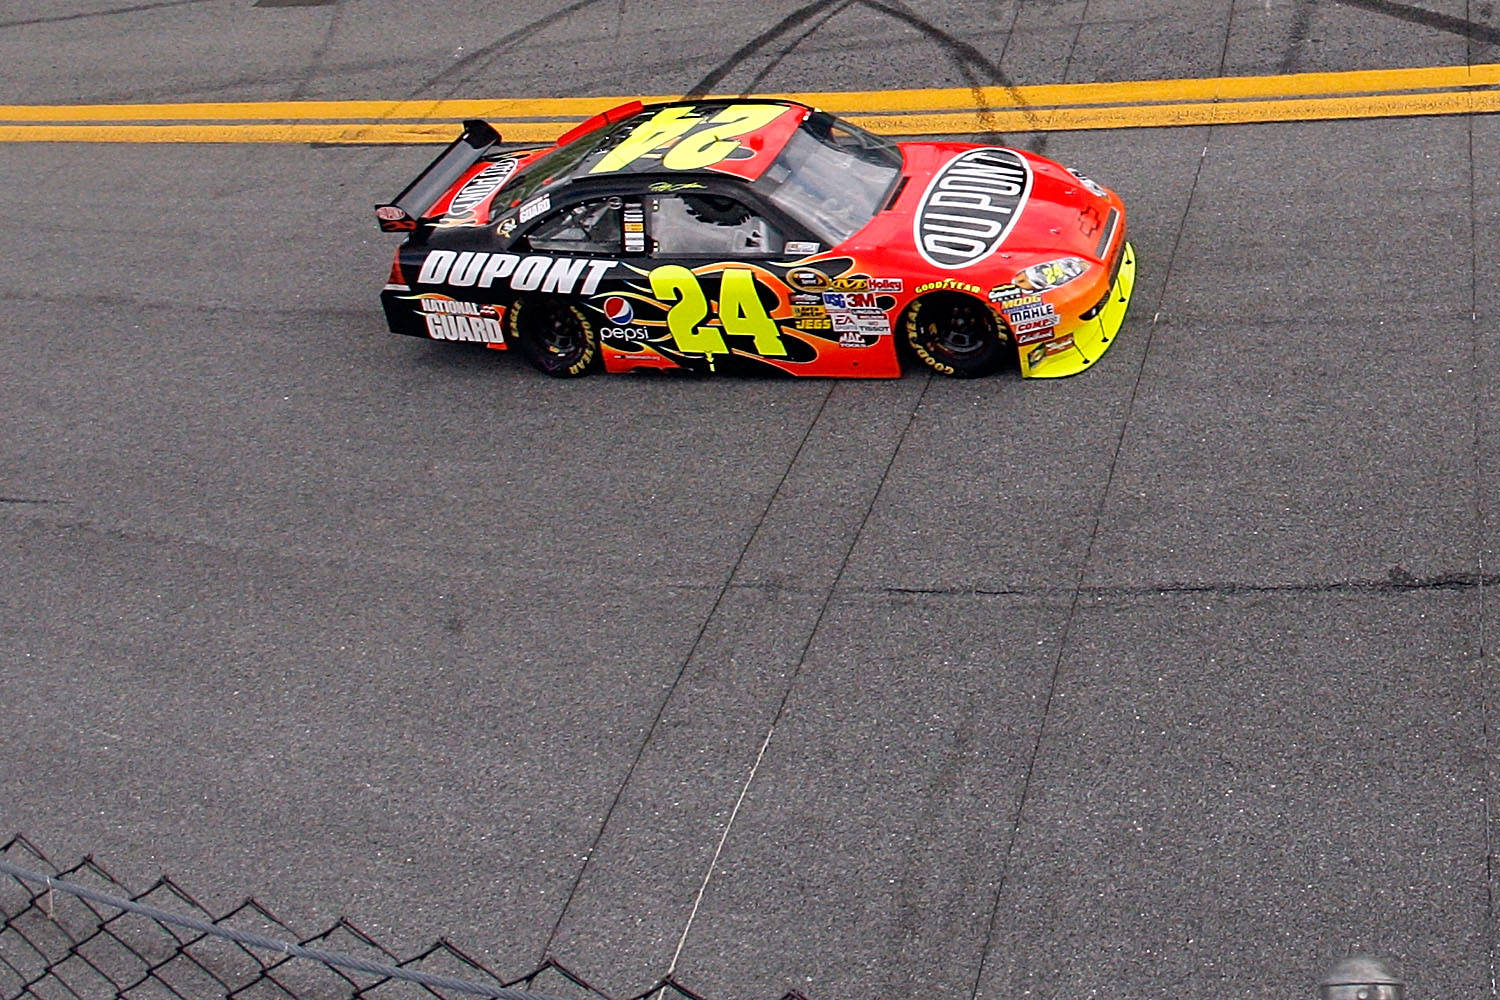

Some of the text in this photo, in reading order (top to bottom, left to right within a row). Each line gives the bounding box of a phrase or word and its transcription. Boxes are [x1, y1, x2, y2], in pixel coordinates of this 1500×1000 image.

[588, 104, 791, 174] 24
[922, 152, 1025, 258] DUPONT
[417, 250, 620, 296] DUPONT
[869, 279, 901, 289] Holley
[914, 277, 981, 294] GOODYEAR
[421, 298, 481, 317] NATIONAL
[649, 264, 788, 356] 24
[847, 293, 876, 308] 3M
[1002, 295, 1042, 309] MOOG
[1010, 304, 1053, 323] MAHLE
[426, 314, 505, 344] GUARD
[600, 324, 650, 342] pepsi
[795, 319, 831, 330] JEGS
